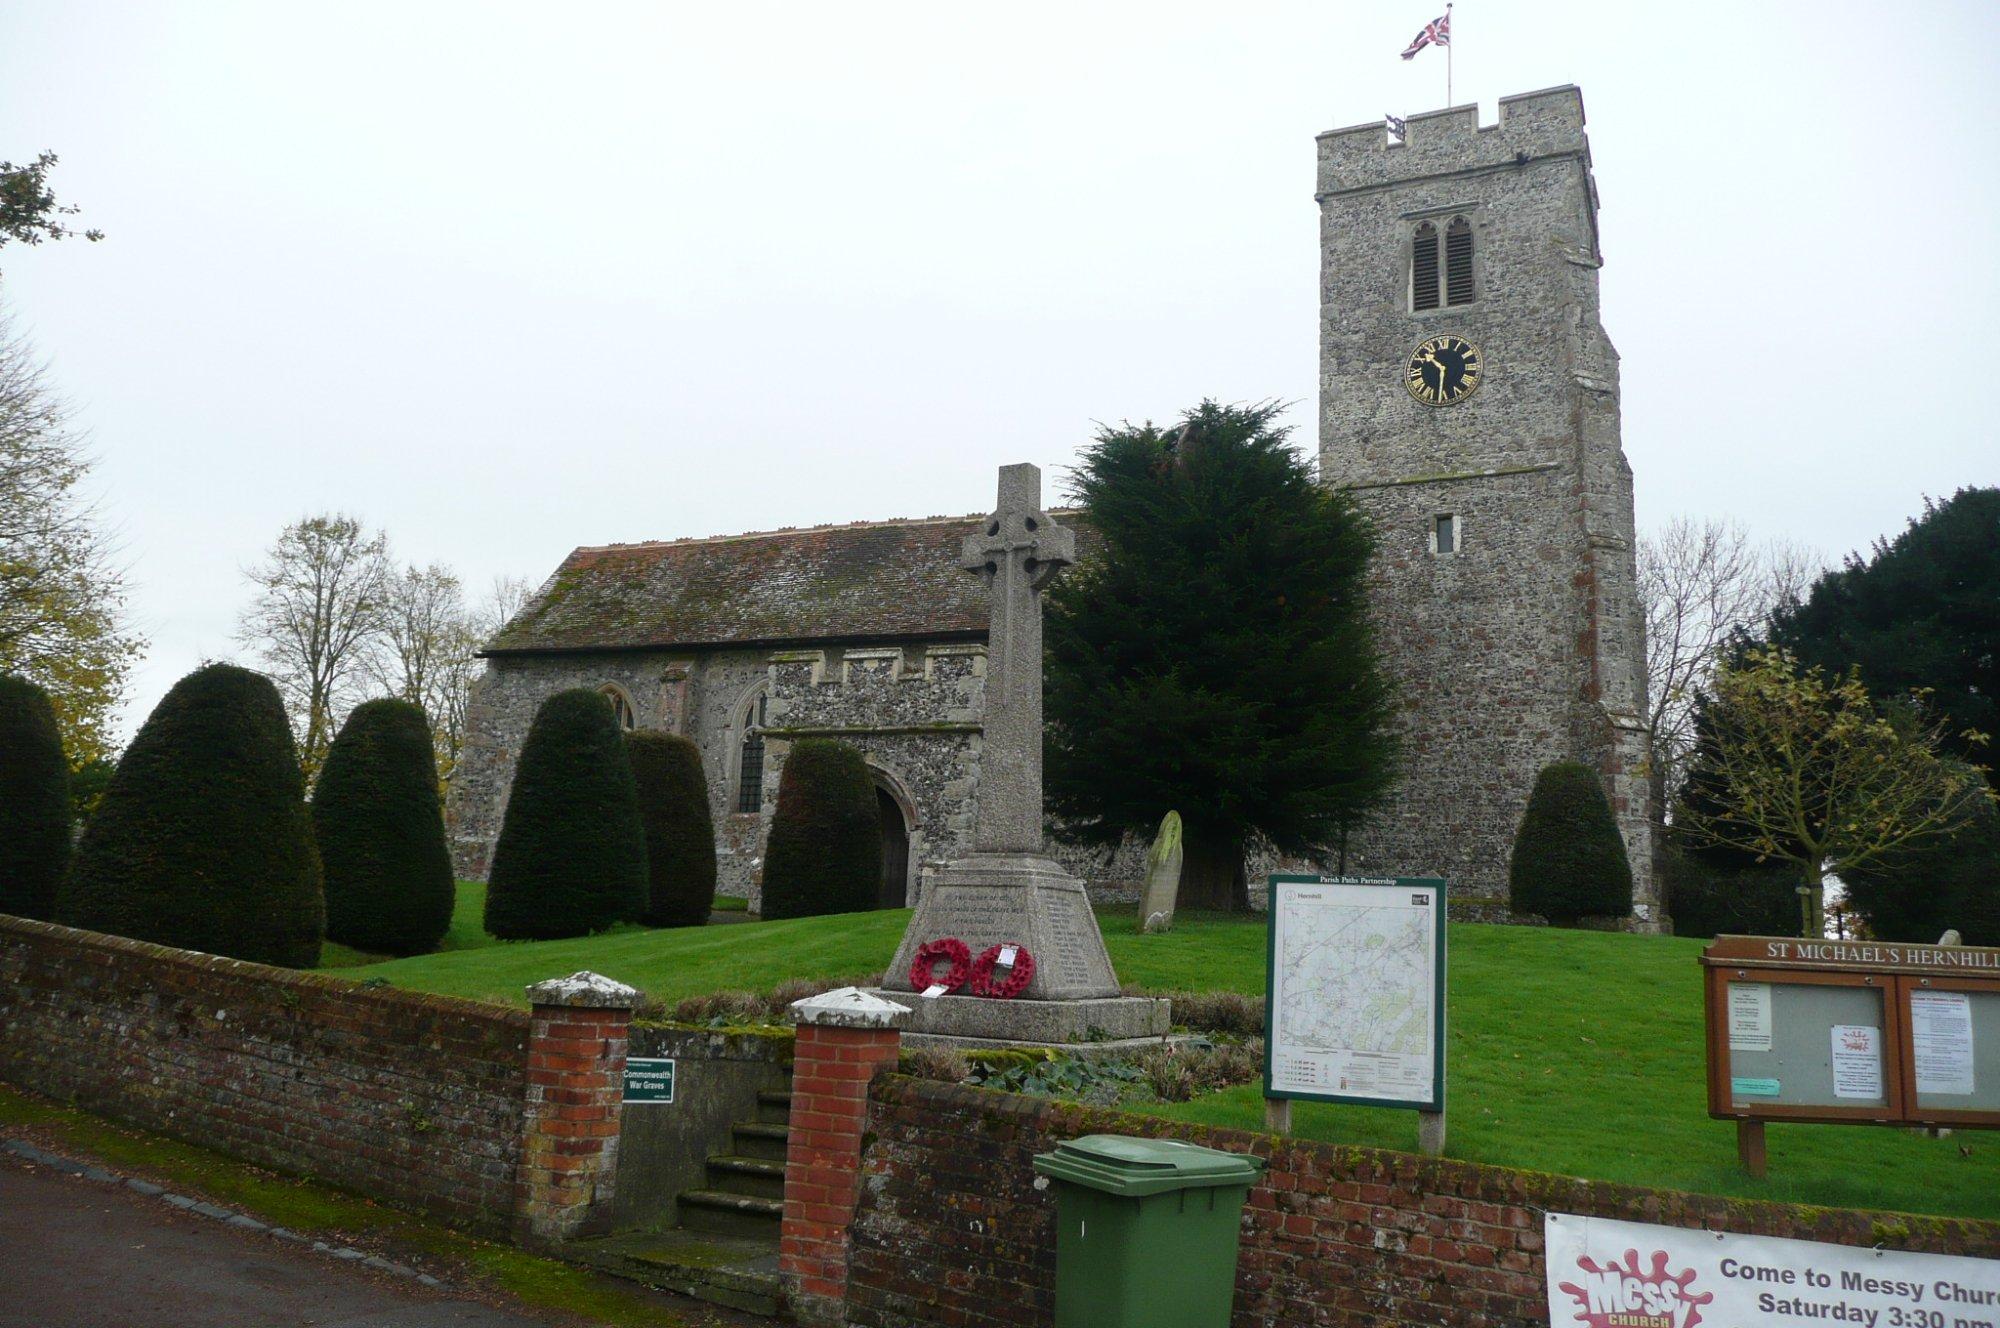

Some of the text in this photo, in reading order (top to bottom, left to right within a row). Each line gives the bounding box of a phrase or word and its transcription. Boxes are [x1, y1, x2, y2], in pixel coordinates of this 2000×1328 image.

[1320, 876, 1340, 884] Parish
[1360, 877, 1397, 886] Partnership
[1768, 942, 2000, 968] ST MICHAEL'S HERNHILL
[623, 1069, 671, 1079] Commonwealth
[630, 1081, 664, 1090] War Graves
[1720, 1258, 2000, 1306] Come to Messy Chur
[1586, 1270, 1692, 1328] Messy
[1758, 1292, 1879, 1328] Saturday
[1888, 1306, 1945, 1328] 3:30
[1608, 1313, 1670, 1328] CHURCH
